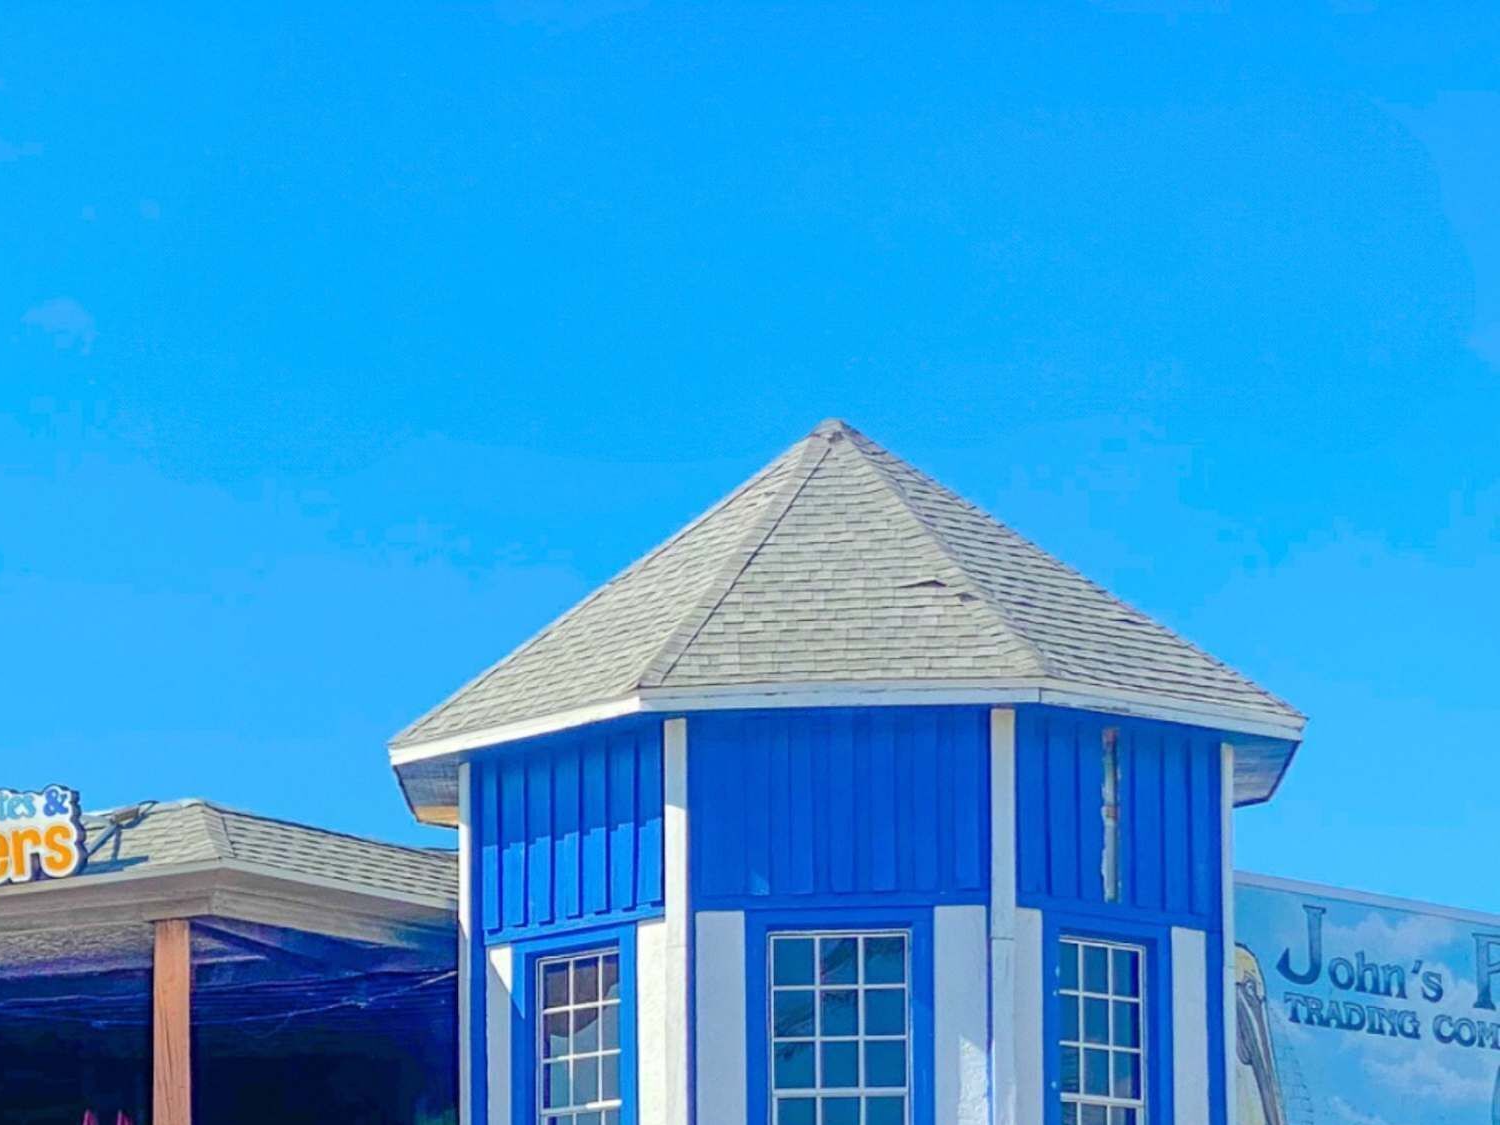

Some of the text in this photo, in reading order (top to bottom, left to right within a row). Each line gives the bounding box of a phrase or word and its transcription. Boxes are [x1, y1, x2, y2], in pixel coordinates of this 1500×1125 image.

[43, 789, 70, 817] &
[1276, 904, 1444, 1003] John's
[1284, 992, 1421, 1040] TRADING
